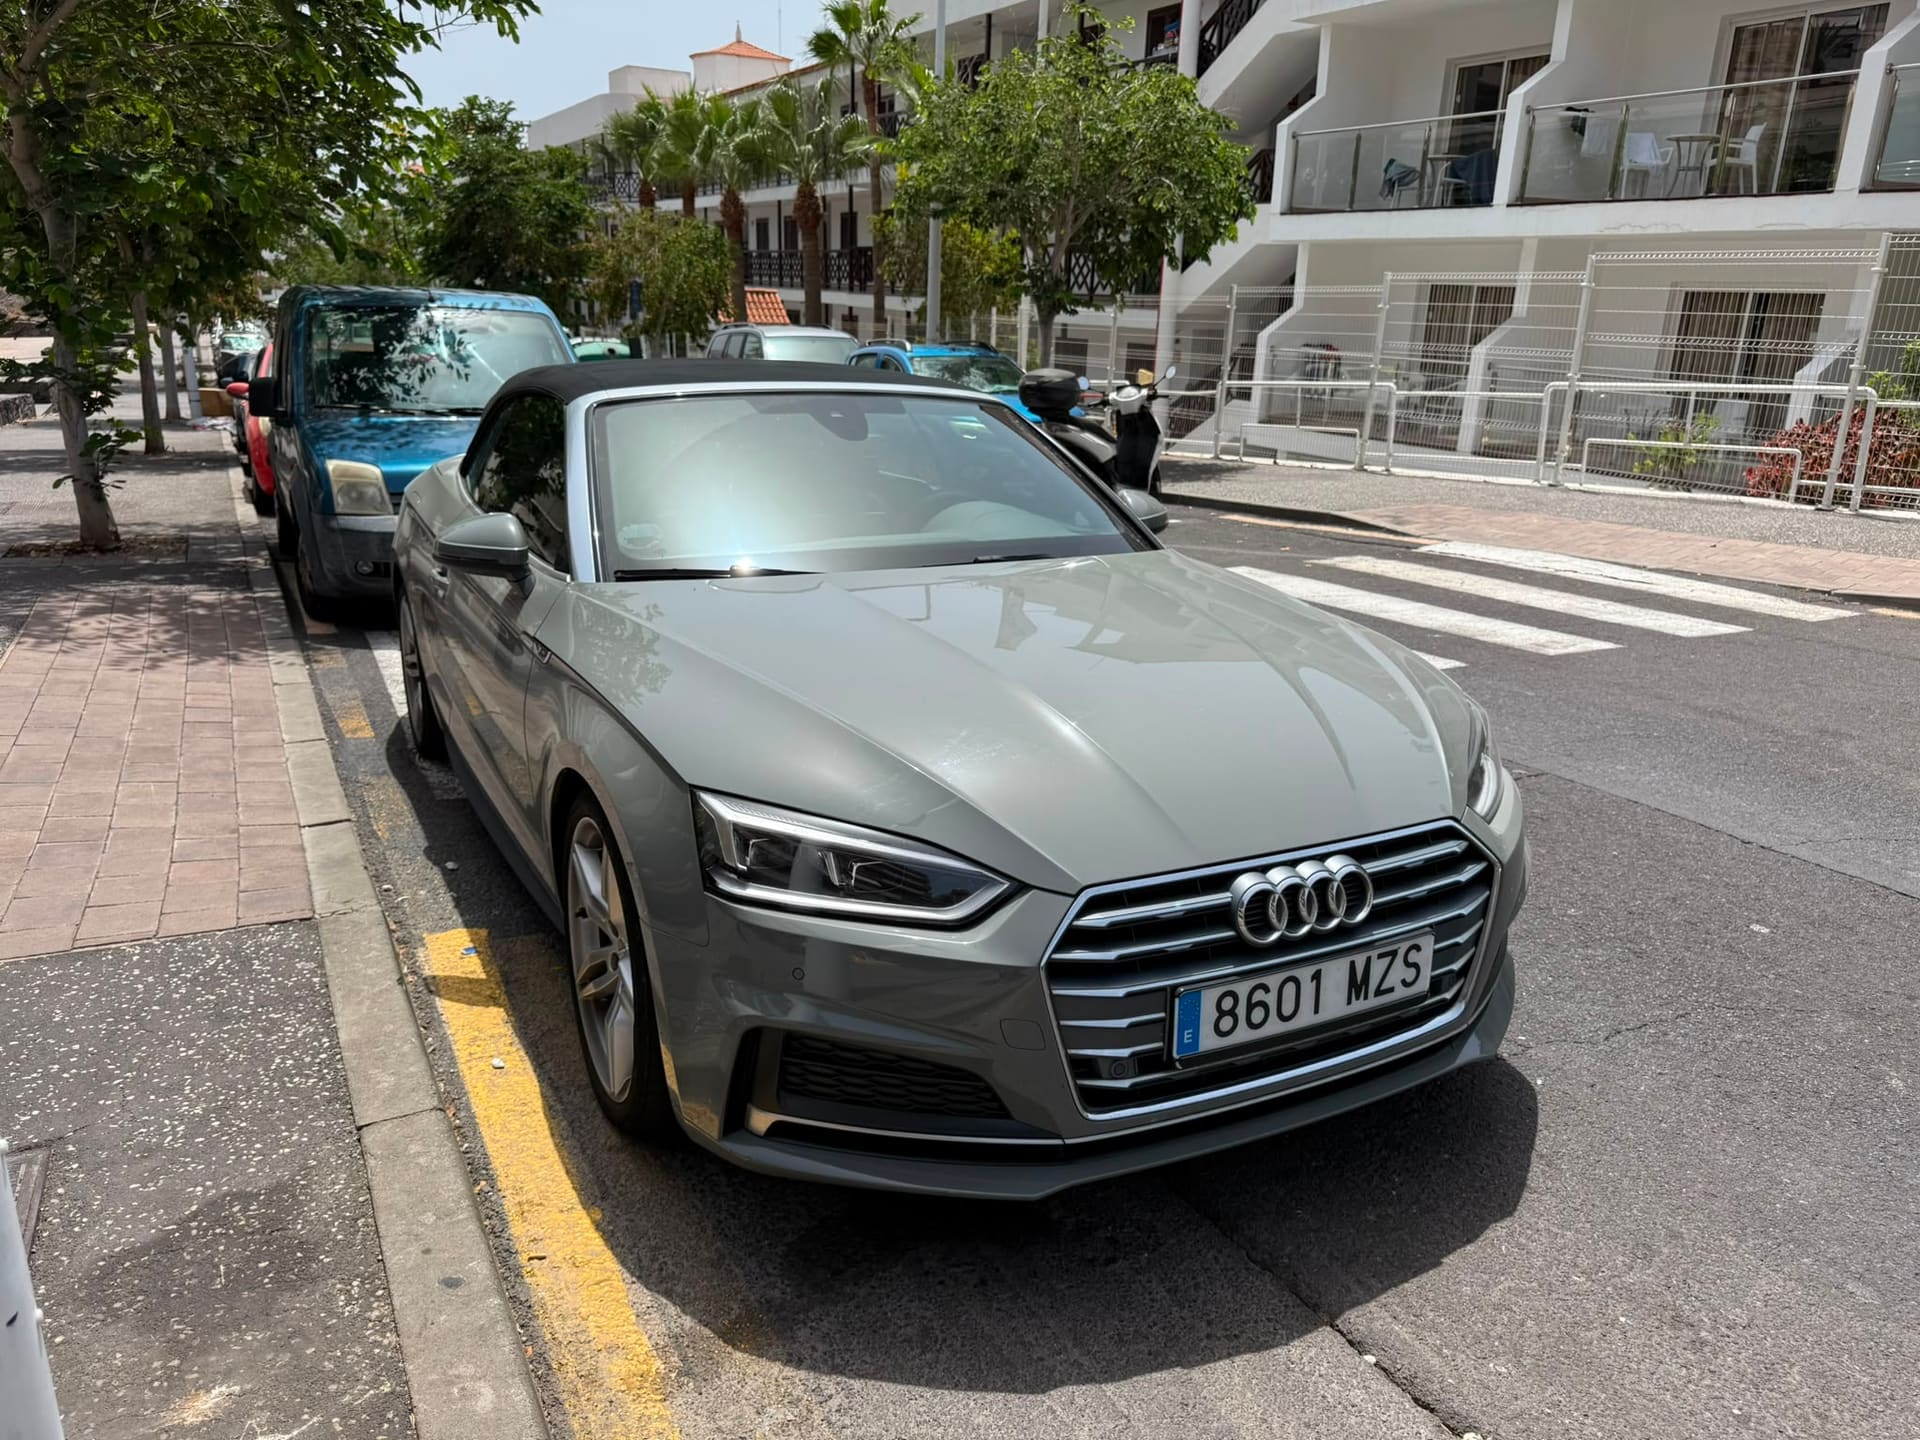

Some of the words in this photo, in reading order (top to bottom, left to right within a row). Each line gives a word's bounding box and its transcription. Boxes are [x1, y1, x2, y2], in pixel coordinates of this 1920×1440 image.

[1213, 968, 1322, 1037] 8601
[1347, 943, 1421, 1005] MZS
[1183, 1028, 1193, 1043] E
